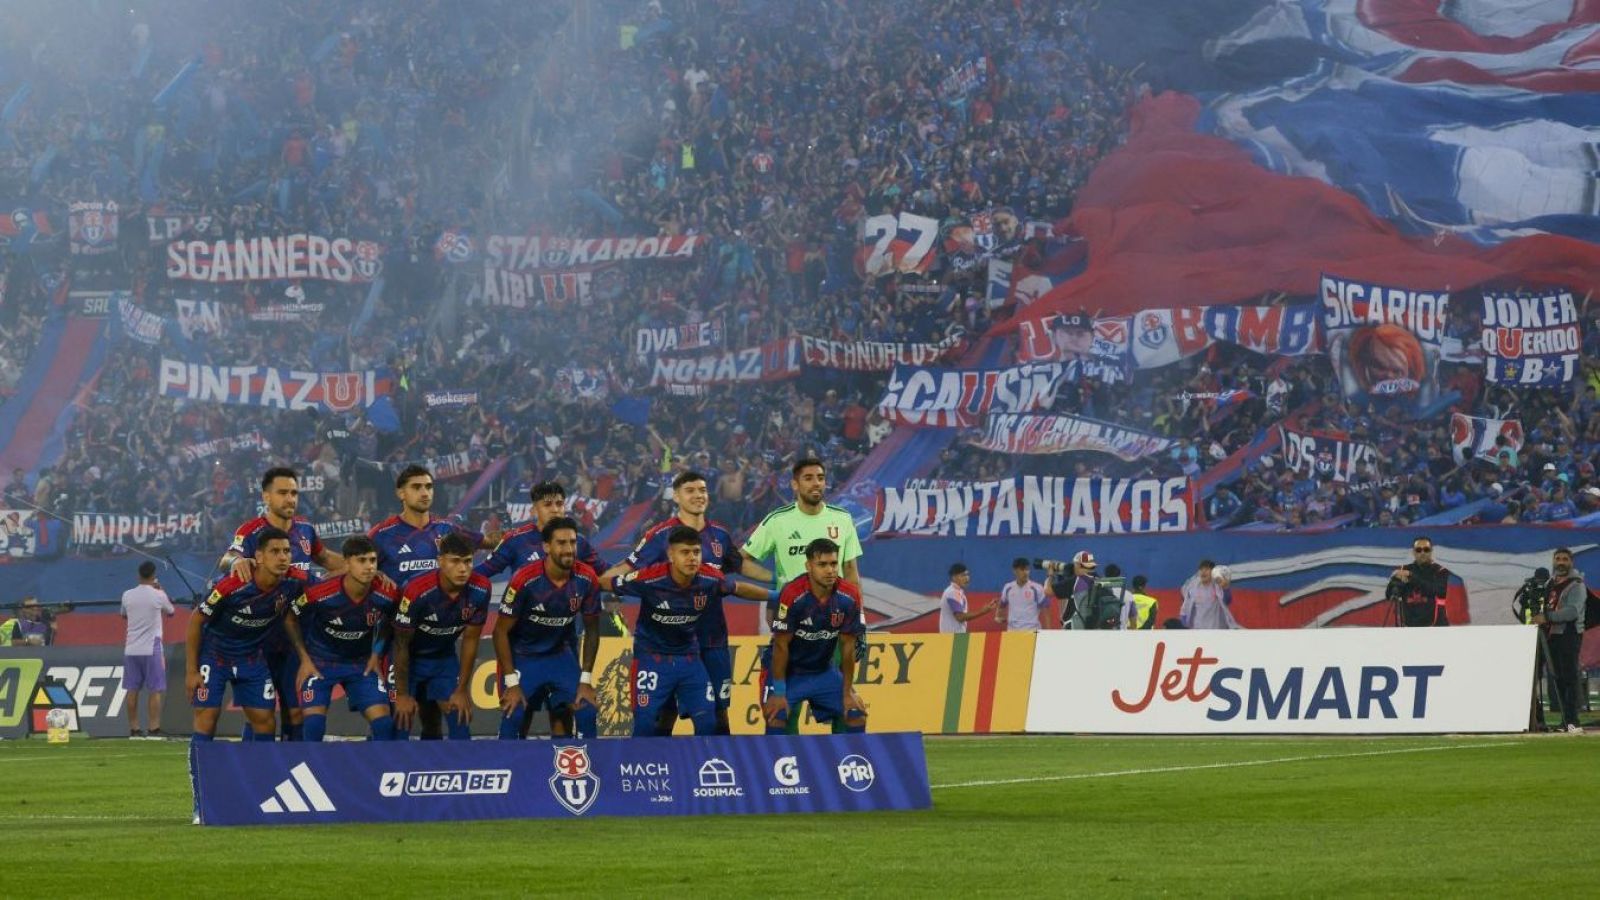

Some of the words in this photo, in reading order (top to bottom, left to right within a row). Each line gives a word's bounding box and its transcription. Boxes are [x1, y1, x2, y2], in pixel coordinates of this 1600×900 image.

[167, 234, 352, 281] SCANNERS
[865, 212, 940, 276] 27
[1322, 278, 1449, 345] SICARIOS
[1483, 293, 1577, 328] JOKER
[1482, 326, 1580, 359] QUERIDO
[876, 475, 1188, 537] MONTANIAKOS
[73, 513, 148, 546] MAIPU
[636, 670, 660, 690] 23
[1111, 641, 1445, 722] JetSMART
[620, 763, 669, 776] MACH
[622, 779, 671, 792] BANK
[693, 787, 744, 798] SODIMAC
[768, 786, 810, 795] GATORADE
